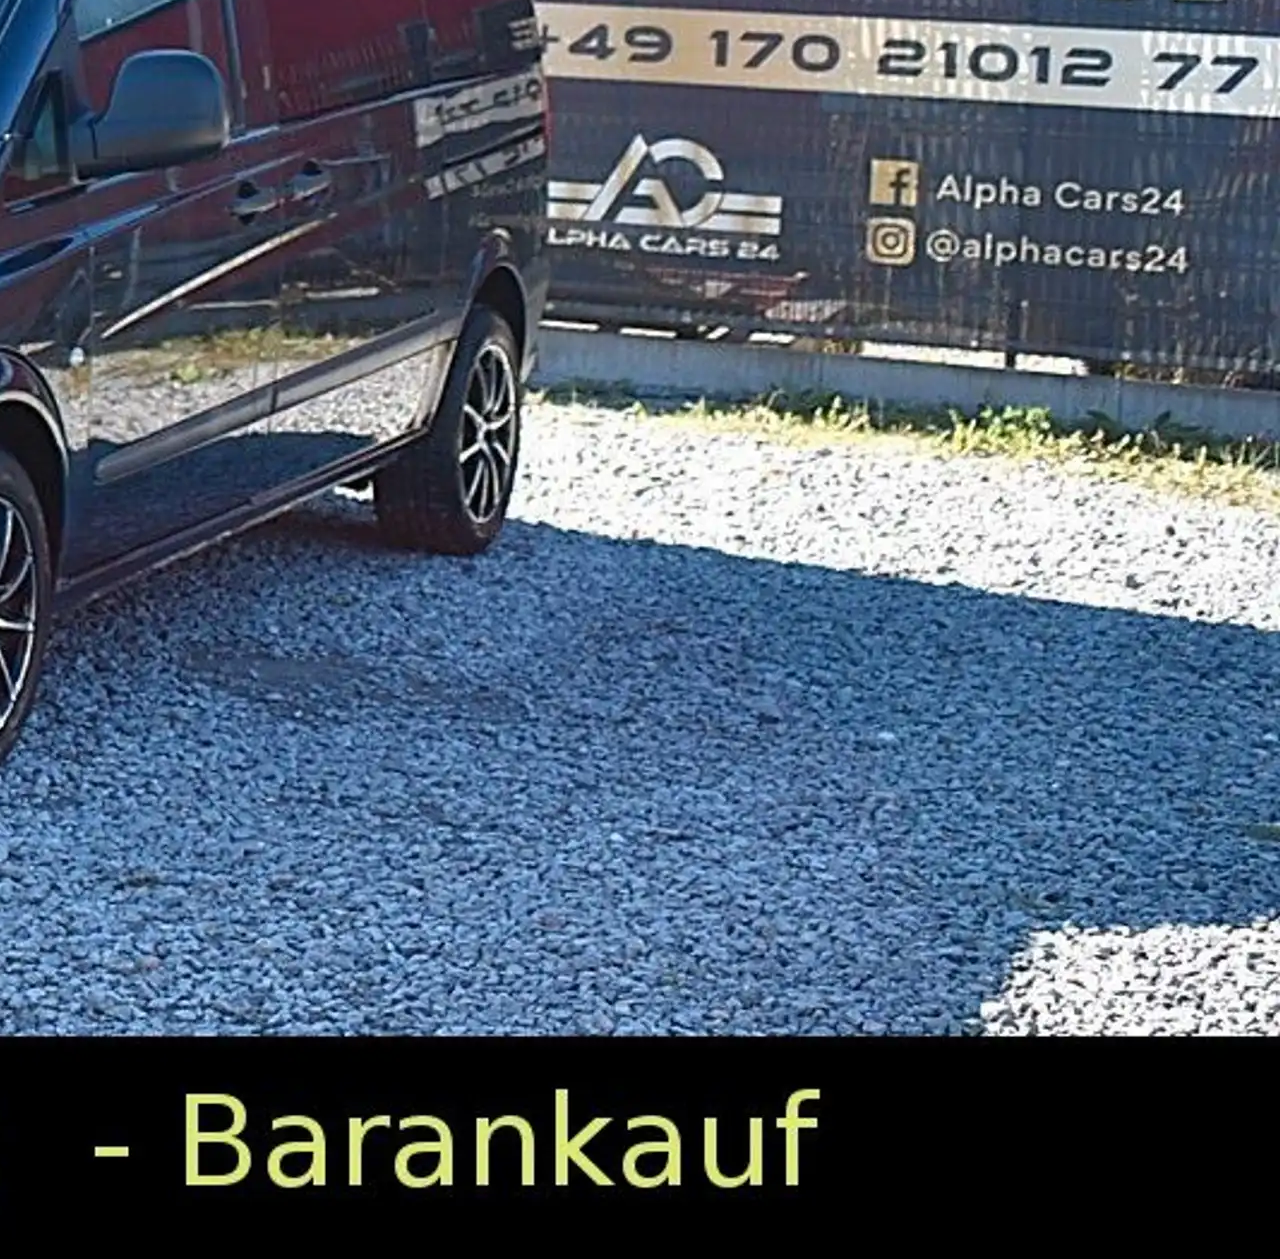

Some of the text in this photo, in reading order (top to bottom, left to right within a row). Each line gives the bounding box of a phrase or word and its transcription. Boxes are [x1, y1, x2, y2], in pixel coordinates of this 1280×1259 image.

[540, 23, 1260, 95] +49 170 21012 77
[936, 173, 1042, 210] Alpha
[1054, 181, 1185, 217] Cars24
[640, 233, 730, 258] CARS
[736, 242, 781, 262] 24
[925, 228, 1189, 274] @alphacars24
